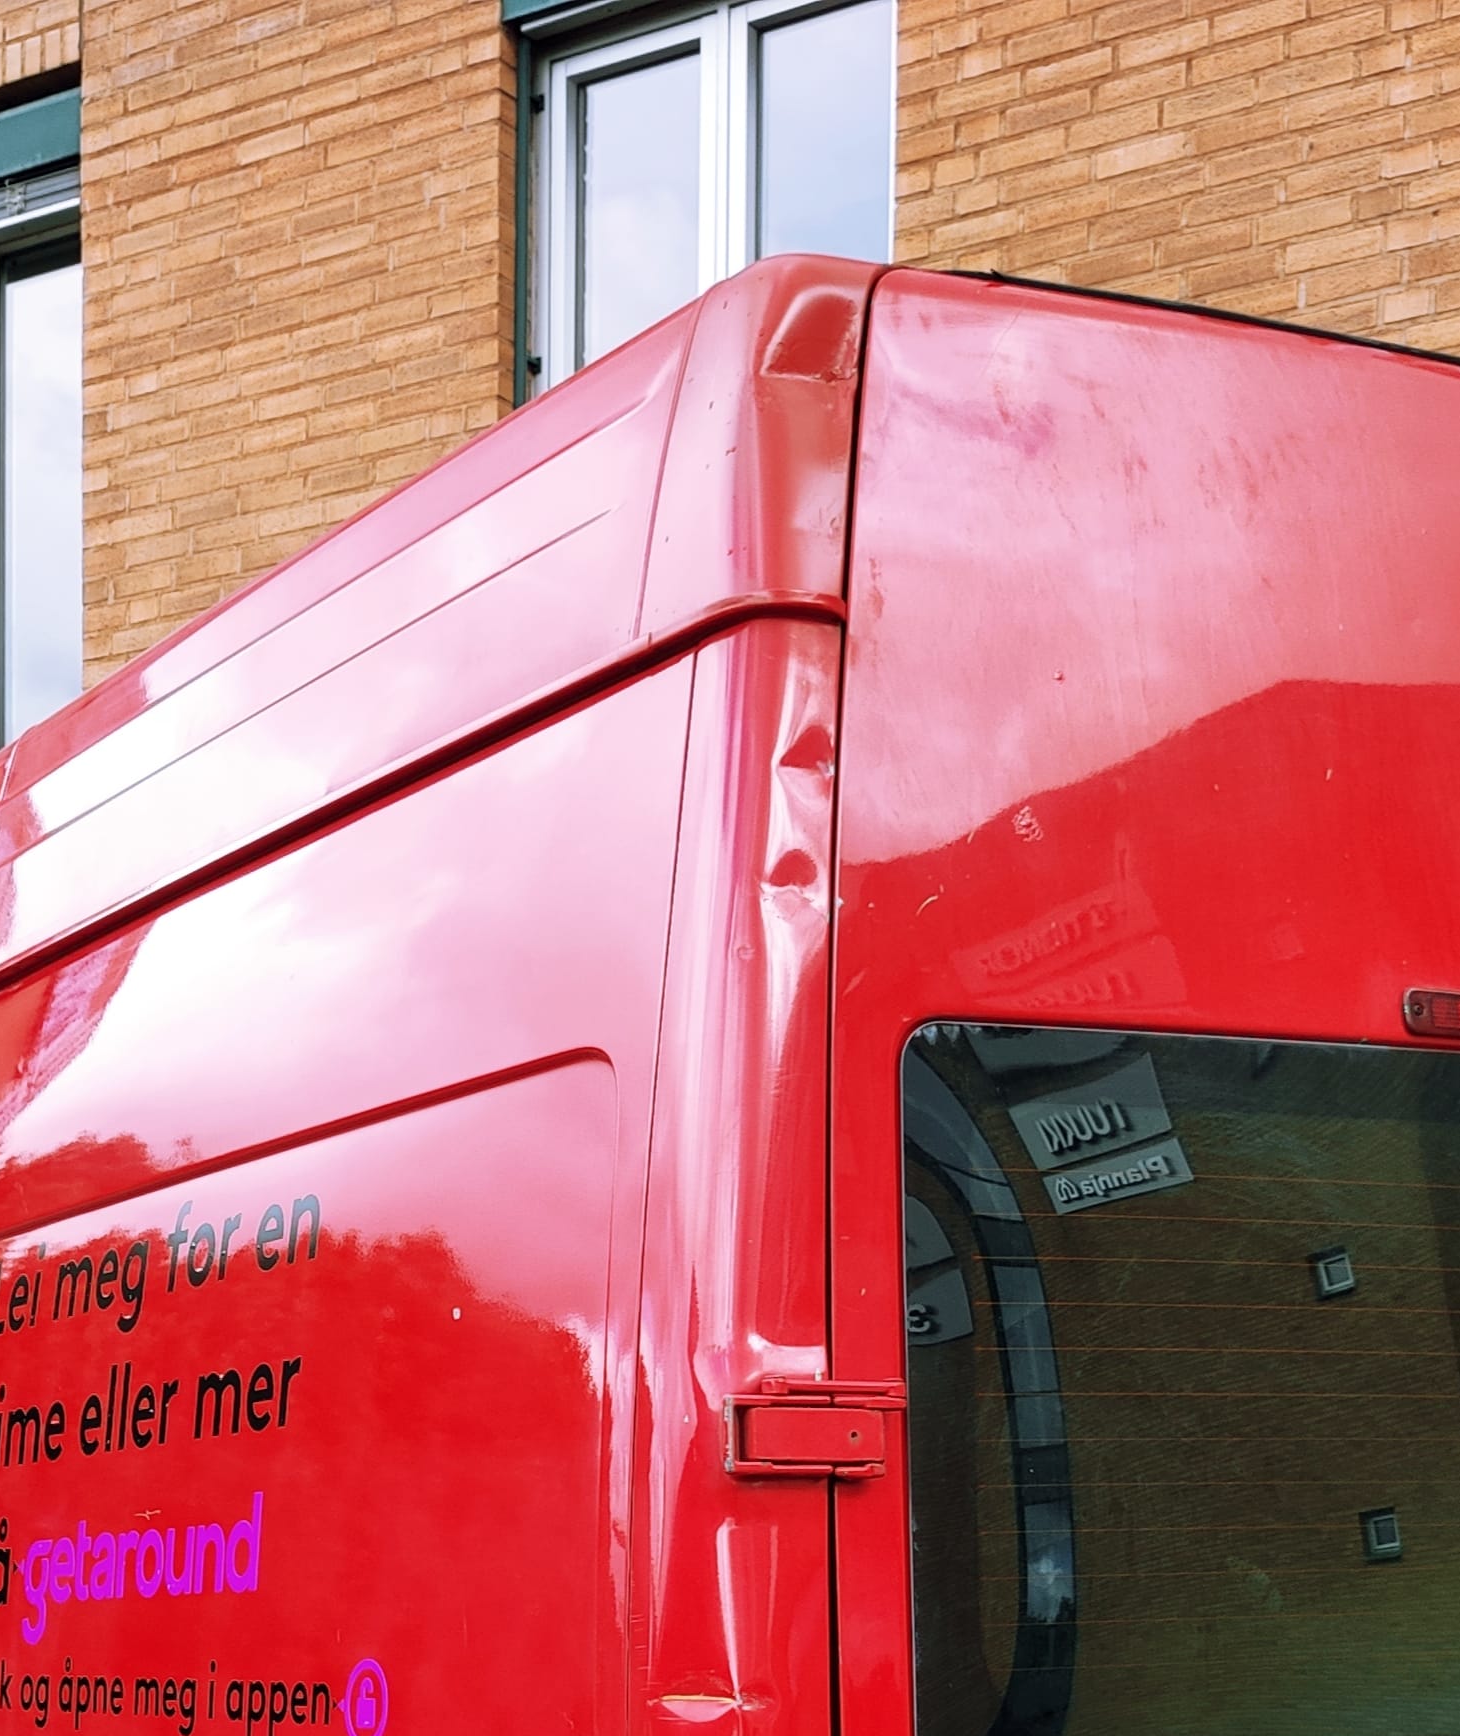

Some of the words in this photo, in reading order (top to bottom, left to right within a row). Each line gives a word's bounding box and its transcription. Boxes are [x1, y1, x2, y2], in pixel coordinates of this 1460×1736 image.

[52, 1239, 150, 1333] meg
[166, 1200, 245, 1293] for
[254, 1192, 323, 1272] en
[78, 1361, 179, 1454] eller
[192, 1355, 303, 1441] mer
[20, 1491, 264, 1646] getaround
[19, 1671, 51, 1728] og
[57, 1656, 125, 1733] åpne
[207, 1661, 217, 1720] i
